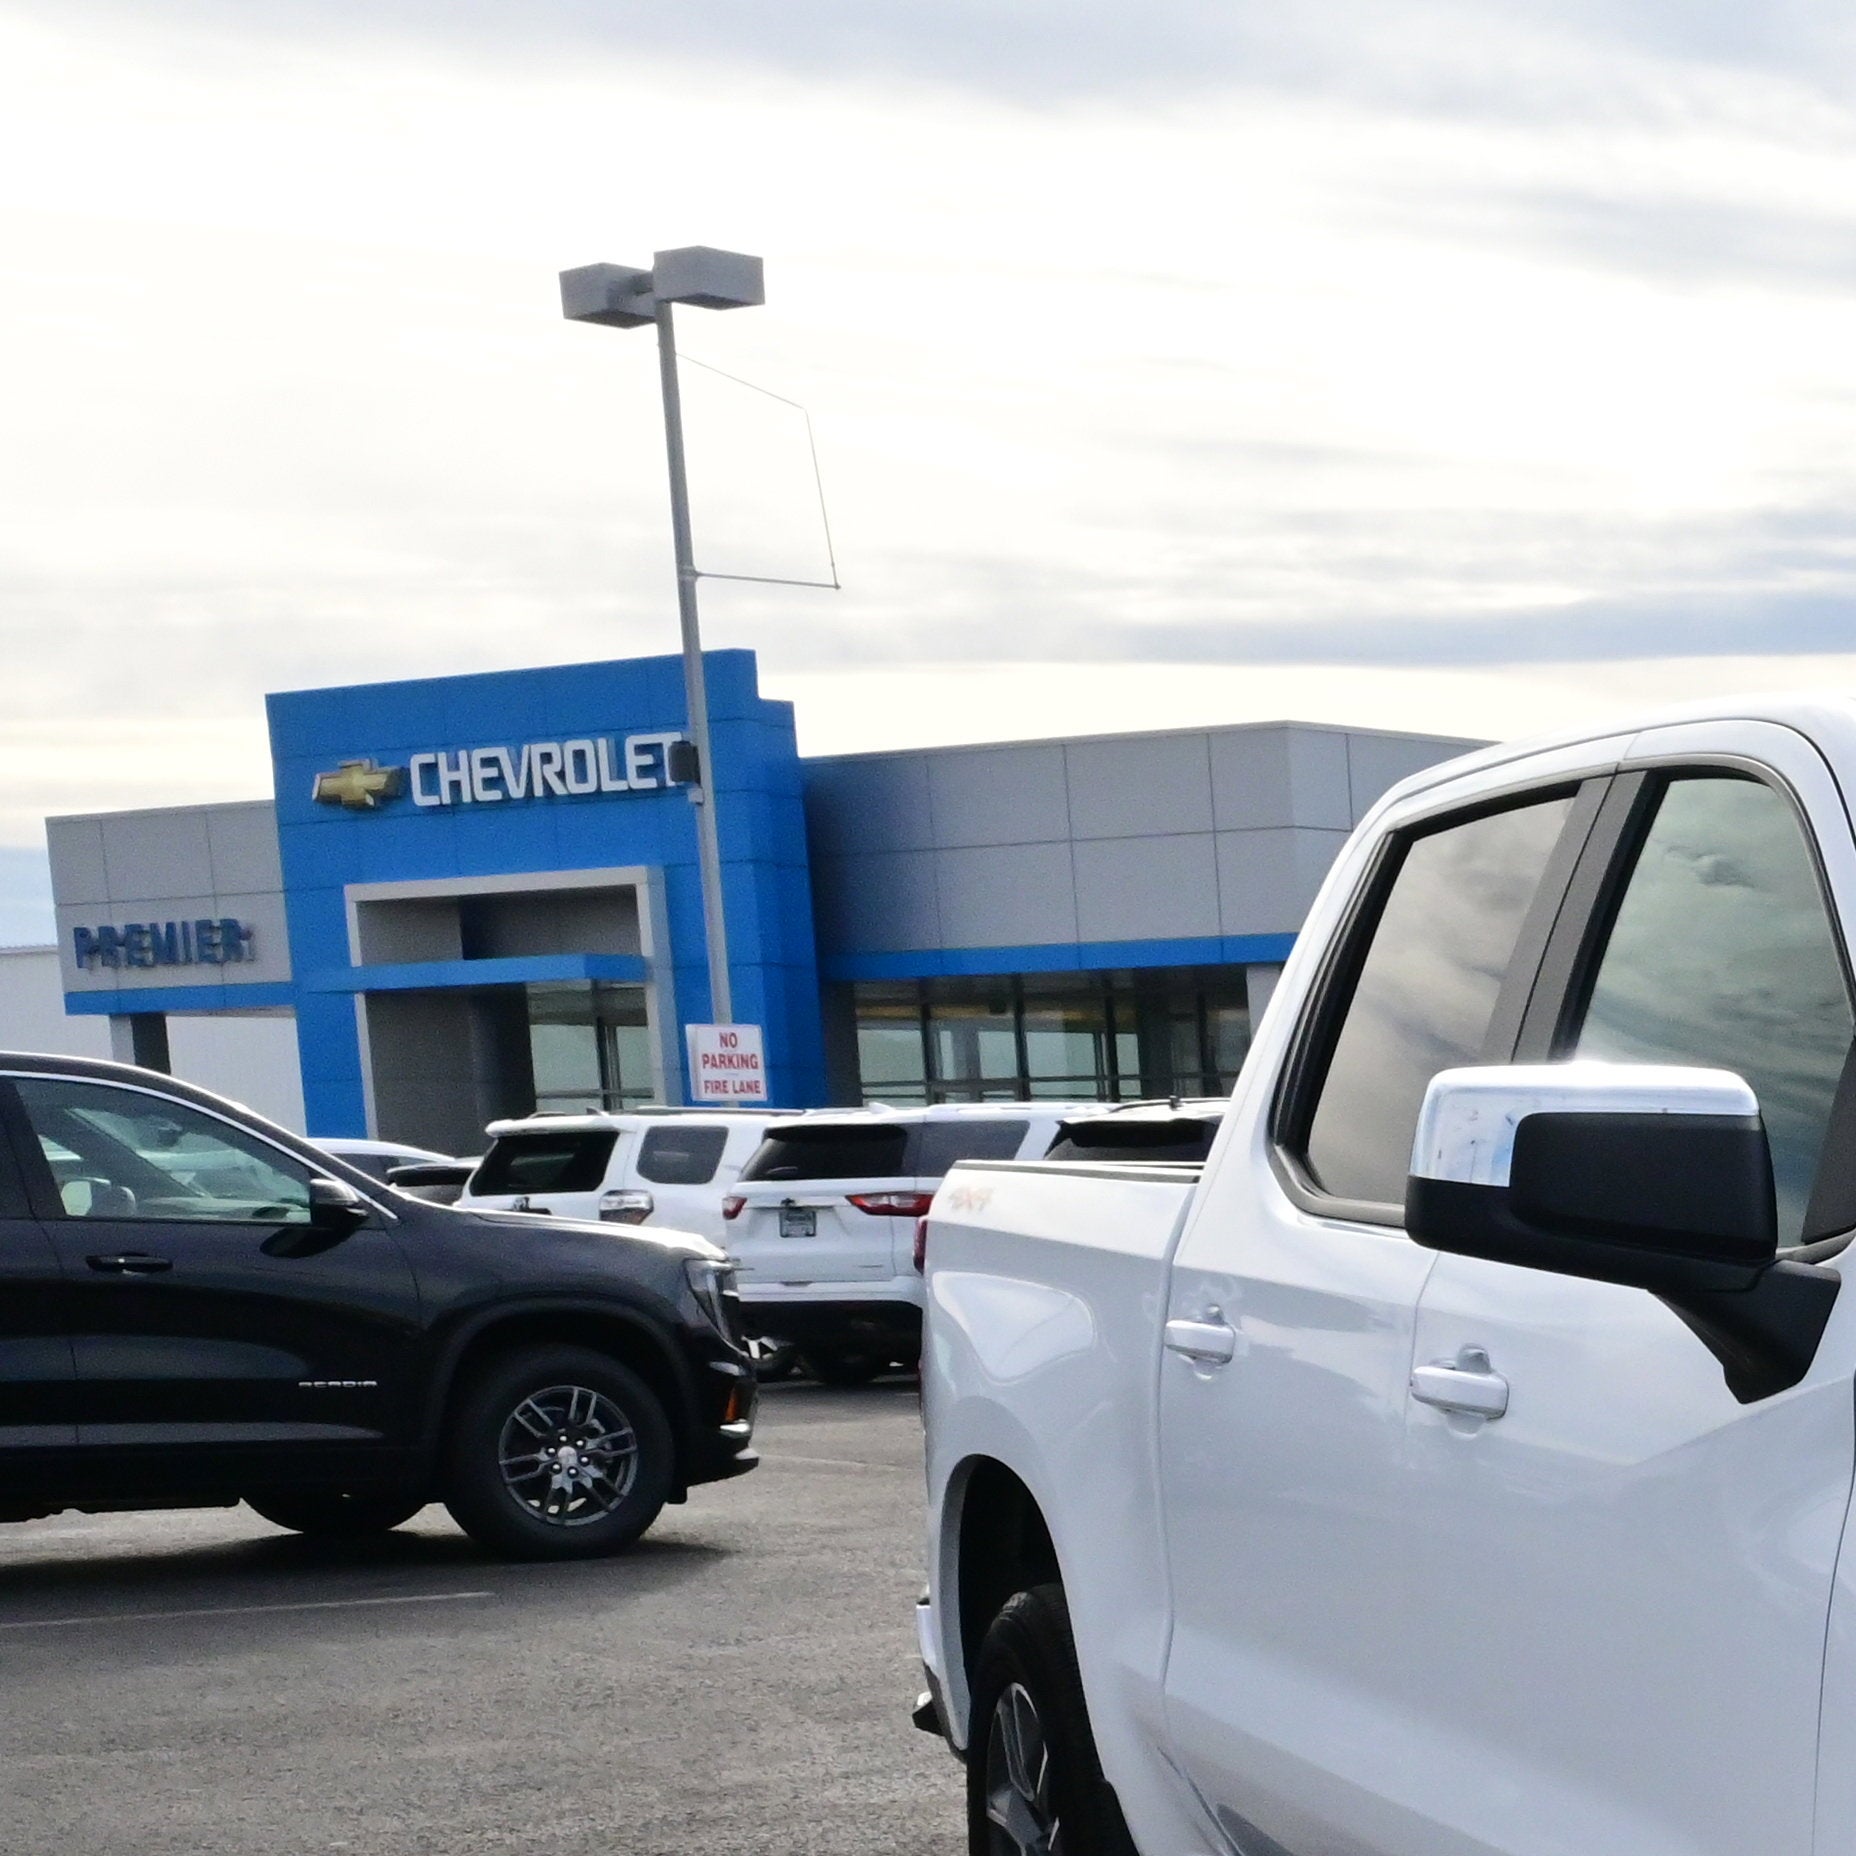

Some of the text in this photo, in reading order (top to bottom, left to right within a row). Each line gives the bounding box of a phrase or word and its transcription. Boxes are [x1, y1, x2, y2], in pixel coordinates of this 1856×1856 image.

[410, 731, 683, 807] CHEVROLET
[73, 918, 249, 969] PREMIER
[719, 1032, 738, 1048] NO
[701, 1053, 759, 1070] PARKING
[704, 1080, 761, 1094] FIRE LANE
